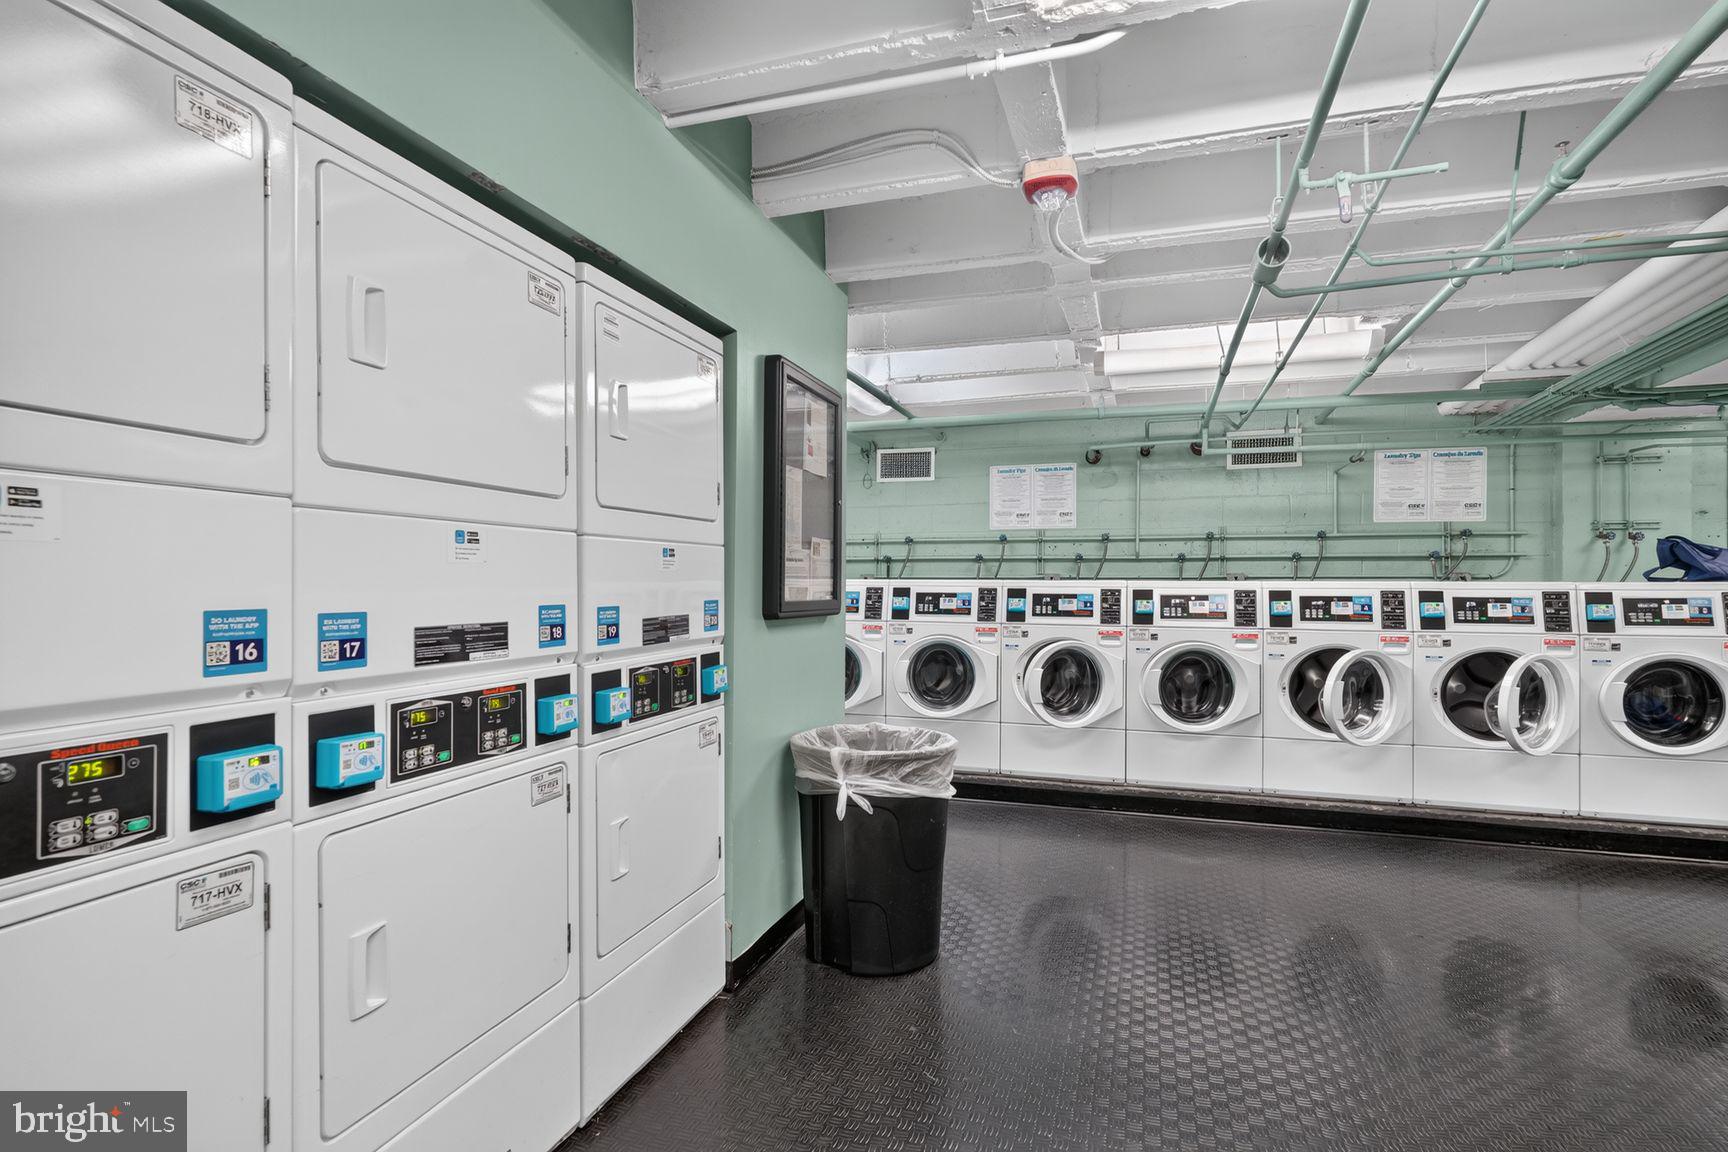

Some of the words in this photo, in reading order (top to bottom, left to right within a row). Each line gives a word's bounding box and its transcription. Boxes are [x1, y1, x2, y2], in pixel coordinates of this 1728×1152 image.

[188, 100, 241, 134] 718-HVX
[552, 627, 562, 638] 18
[608, 625, 617, 637] 19
[235, 642, 258, 661] 16
[343, 641, 361, 658] 17
[50, 744, 96, 759] Speed
[97, 739, 140, 752] Queen
[68, 761, 103, 780] 275
[191, 882, 243, 907] 717-HVX
